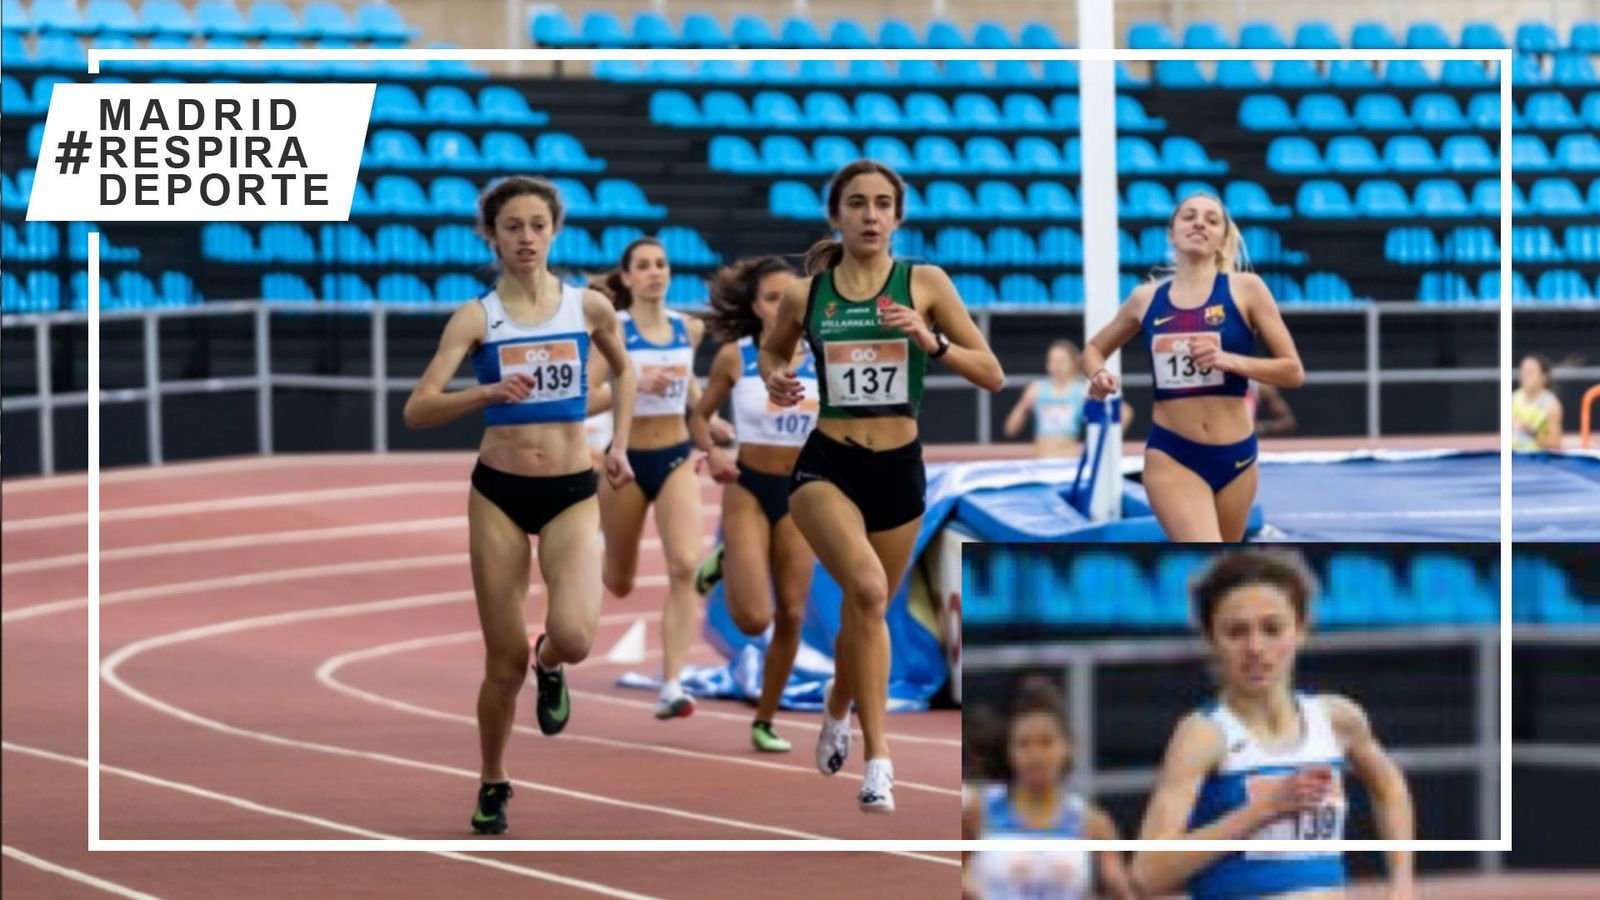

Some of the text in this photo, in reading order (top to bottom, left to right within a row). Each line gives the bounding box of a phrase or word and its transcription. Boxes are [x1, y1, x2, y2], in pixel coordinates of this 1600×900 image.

[533, 363, 573, 391] 139
[843, 366, 898, 394] 137
[774, 413, 811, 434] 107
